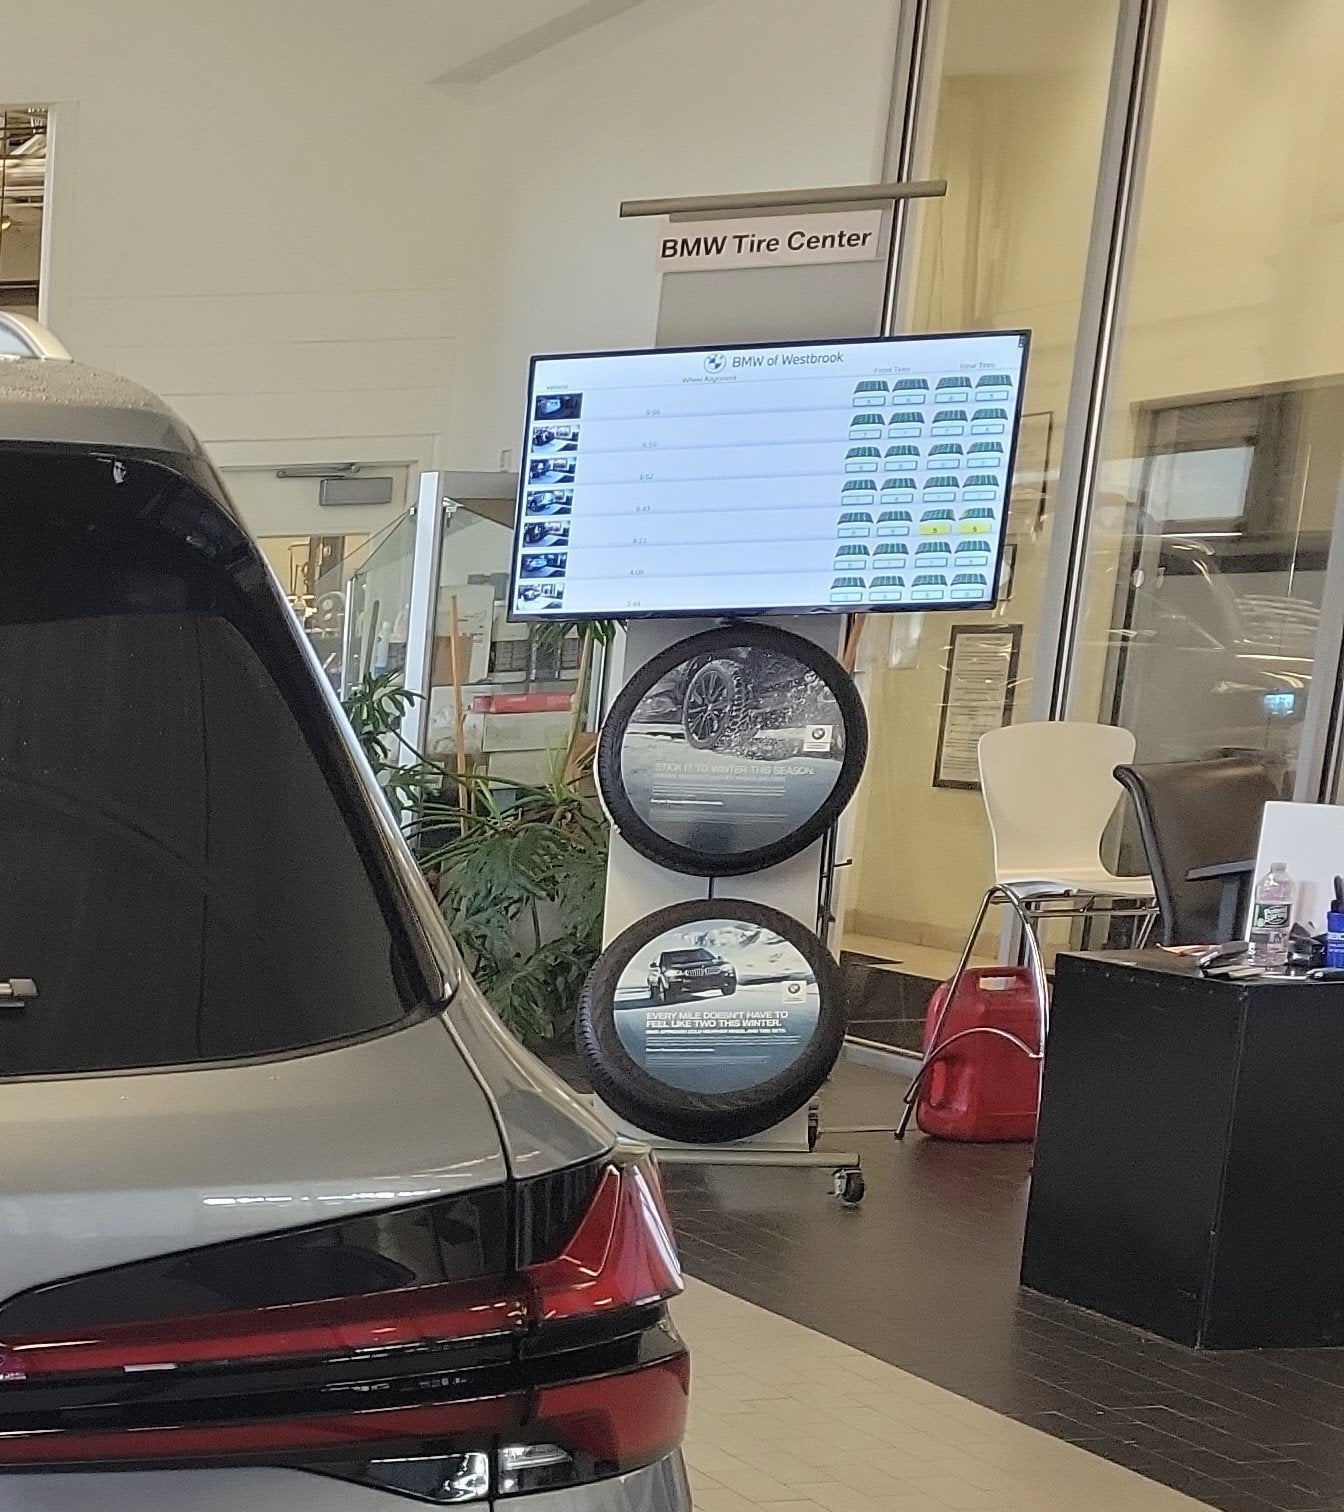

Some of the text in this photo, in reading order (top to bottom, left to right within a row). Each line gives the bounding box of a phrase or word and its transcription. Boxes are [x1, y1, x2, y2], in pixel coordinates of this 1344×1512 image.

[661, 230, 872, 258] BMW Tire Center
[732, 352, 844, 368] BMW of Westbrook
[646, 1011, 789, 1020] EVERY MILE DOESN'T HAVE TO
[646, 1020, 670, 1028] FEEL
[671, 1020, 692, 1028] LIKE
[693, 1020, 717, 1028] TWO
[742, 1019, 782, 1027] WINTER.
